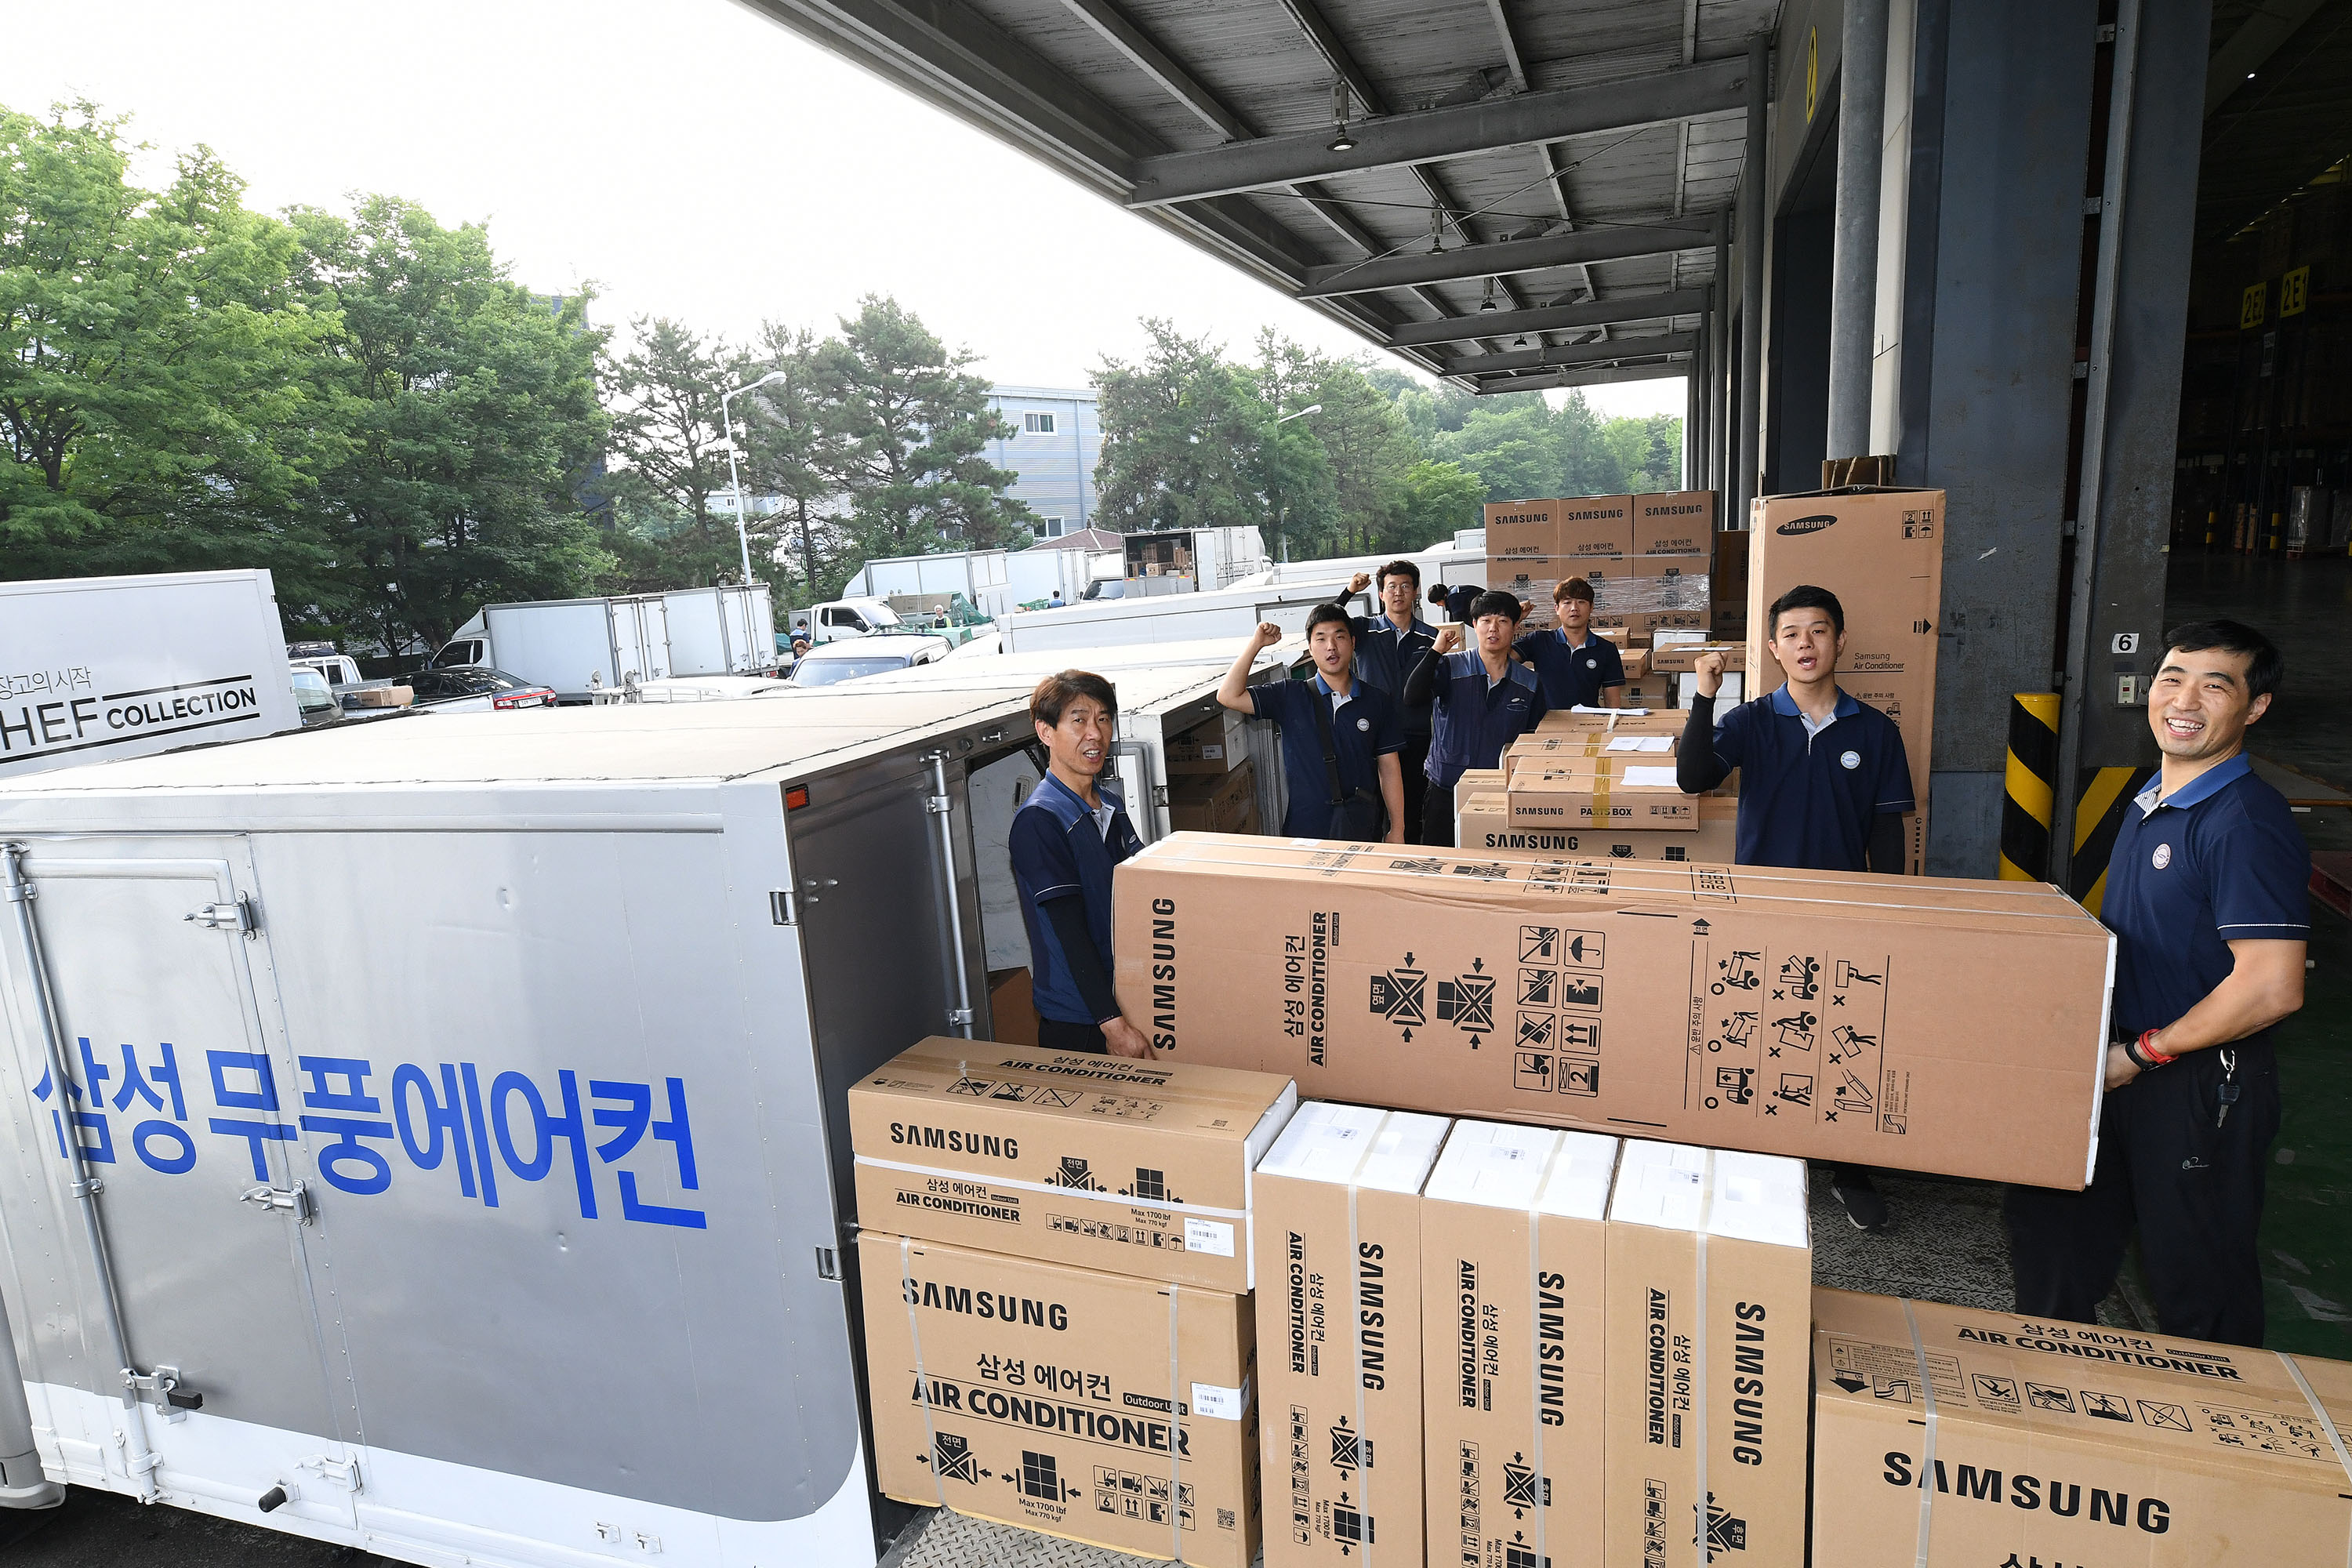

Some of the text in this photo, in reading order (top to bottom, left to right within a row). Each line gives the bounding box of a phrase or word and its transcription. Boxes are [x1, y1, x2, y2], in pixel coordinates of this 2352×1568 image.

[2282, 272, 2307, 312] 2E1
[1495, 513, 1548, 524] SAMSUNG
[1568, 509, 1624, 521] SAMSUNG
[1646, 504, 1703, 517] SAMSUNG
[1784, 521, 1831, 531] SAMSUNG
[2118, 633, 2132, 651] 6
[1854, 652, 1890, 662] Samsung
[56, 666, 93, 691] 시작
[107, 687, 257, 729] COLLECTION
[1515, 806, 1564, 816] SAMSUNG
[1581, 808, 1632, 816] PARTS BOX
[1486, 833, 1579, 851] SAMSUNG
[1152, 898, 1176, 1051] SAMSUNG
[1284, 935, 1305, 1038] 삼성 에어컨
[1310, 911, 1327, 1067] AIR CONDITIONER
[1372, 983, 1385, 1006] 옆면
[1691, 996, 1703, 1044] 운반 주의 사항
[999, 1060, 1167, 1086] AIR CONDITIONER
[1053, 1055, 1134, 1072] 삼성 에어컨
[31, 1036, 707, 1229] 삼성 무풍에어컨
[890, 1122, 1019, 1160] SAMSUNG
[1066, 1158, 1083, 1170] 전면
[927, 1178, 987, 1200] 삼성 에어컨
[896, 1192, 1021, 1222] AIR CONDITIONER
[1131, 1208, 1171, 1221] Max 1700 lbf
[1118, 1229, 1127, 1239] 12
[901, 1277, 1069, 1331] SAMSUNG
[1289, 1231, 1305, 1374] AIR CONDITIONER
[1309, 1272, 1325, 1342] 삼성 에어컨
[1359, 1242, 1385, 1391] SAMSUNG
[1461, 1260, 1477, 1409] AIR CONDITIONER
[1483, 1303, 1499, 1377] 삼성 에어컨
[2020, 1323, 2155, 1352] 삼성 에어컨
[1538, 1271, 1566, 1427] SAMSUNG
[1958, 1327, 2244, 1381] AIR CONDITIONER
[2167, 1348, 2229, 1363] Outdoor Unit
[976, 1352, 1112, 1403] 삼성 에어컨
[1649, 1287, 1666, 1445] AIR CONDITIONER
[1672, 1334, 1691, 1411] 삼성 에어컨
[1733, 1301, 1766, 1466] SAMSUNG
[912, 1377, 961, 1411] AIR
[968, 1388, 1191, 1456] CONDITIONER
[1125, 1395, 1185, 1414] Outdoor Uit
[941, 1434, 963, 1449] 전면
[1103, 1496, 1110, 1506] 6
[1883, 1451, 2170, 1534] SAMSUNG
[1019, 1497, 1067, 1515] Max 1700 lbf
[1025, 1509, 1062, 1523] Max 770 kgf
[1494, 1538, 1502, 1553] Max
[1732, 1524, 1744, 1544] 후면
